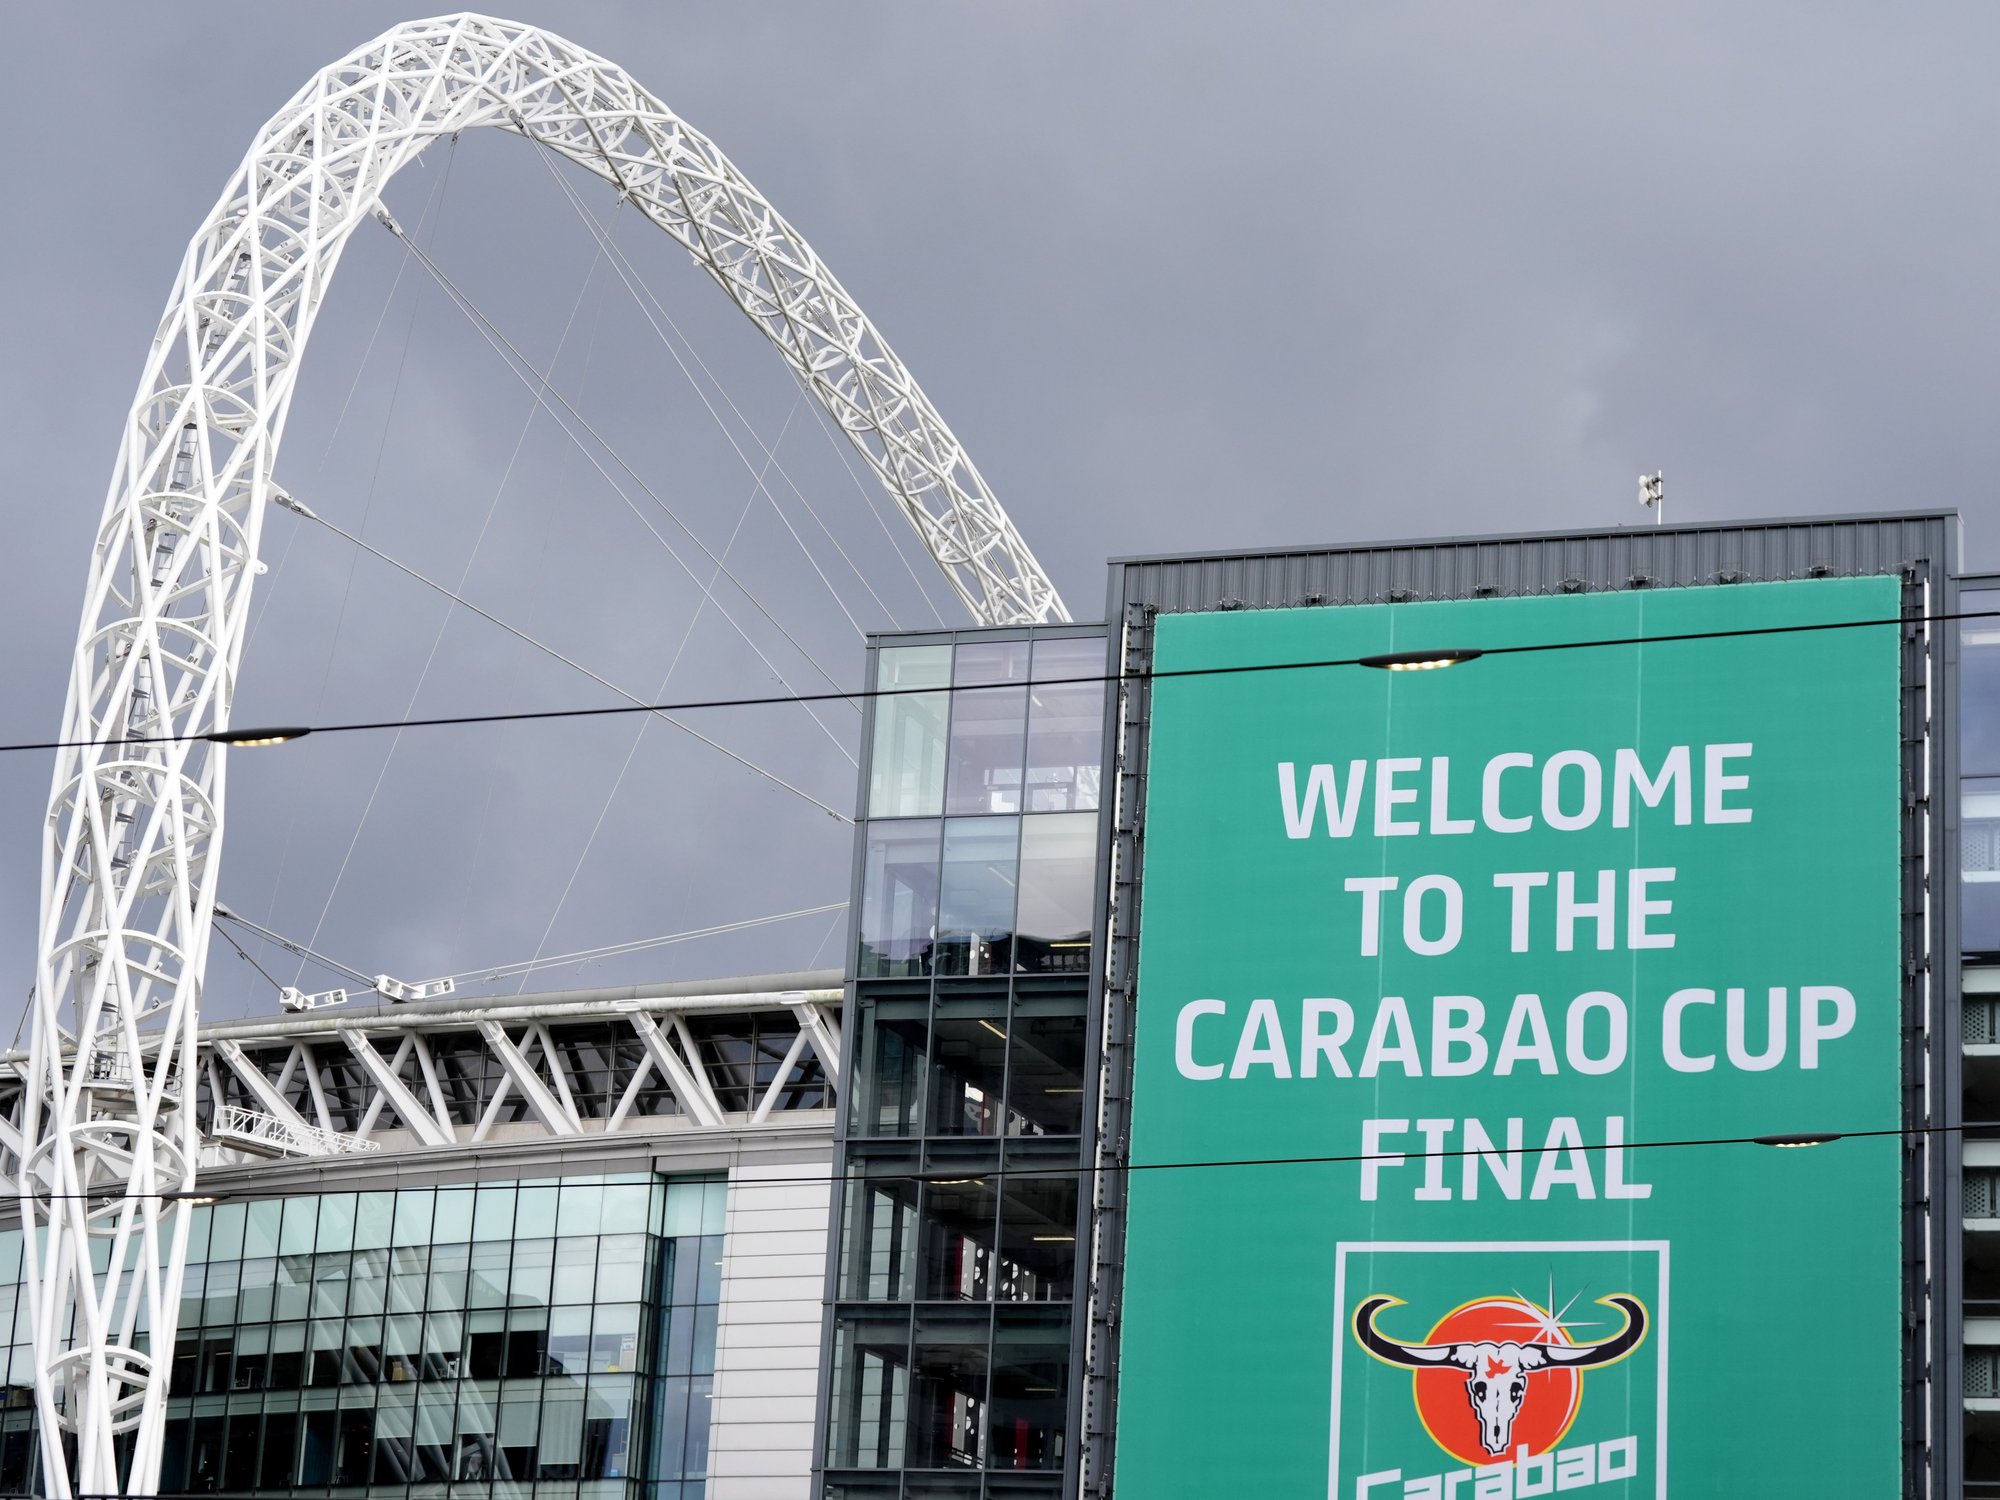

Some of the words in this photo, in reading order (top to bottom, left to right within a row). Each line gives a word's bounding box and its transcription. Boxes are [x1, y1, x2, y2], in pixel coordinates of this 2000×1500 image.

[1278, 743, 1753, 839] WELCOME
[1345, 875, 1464, 956] TO
[1494, 868, 1677, 952] THE
[1175, 991, 1628, 1080] CARABAO
[1662, 986, 1857, 1073] CUP
[1360, 1116, 1653, 1201] FINAL
